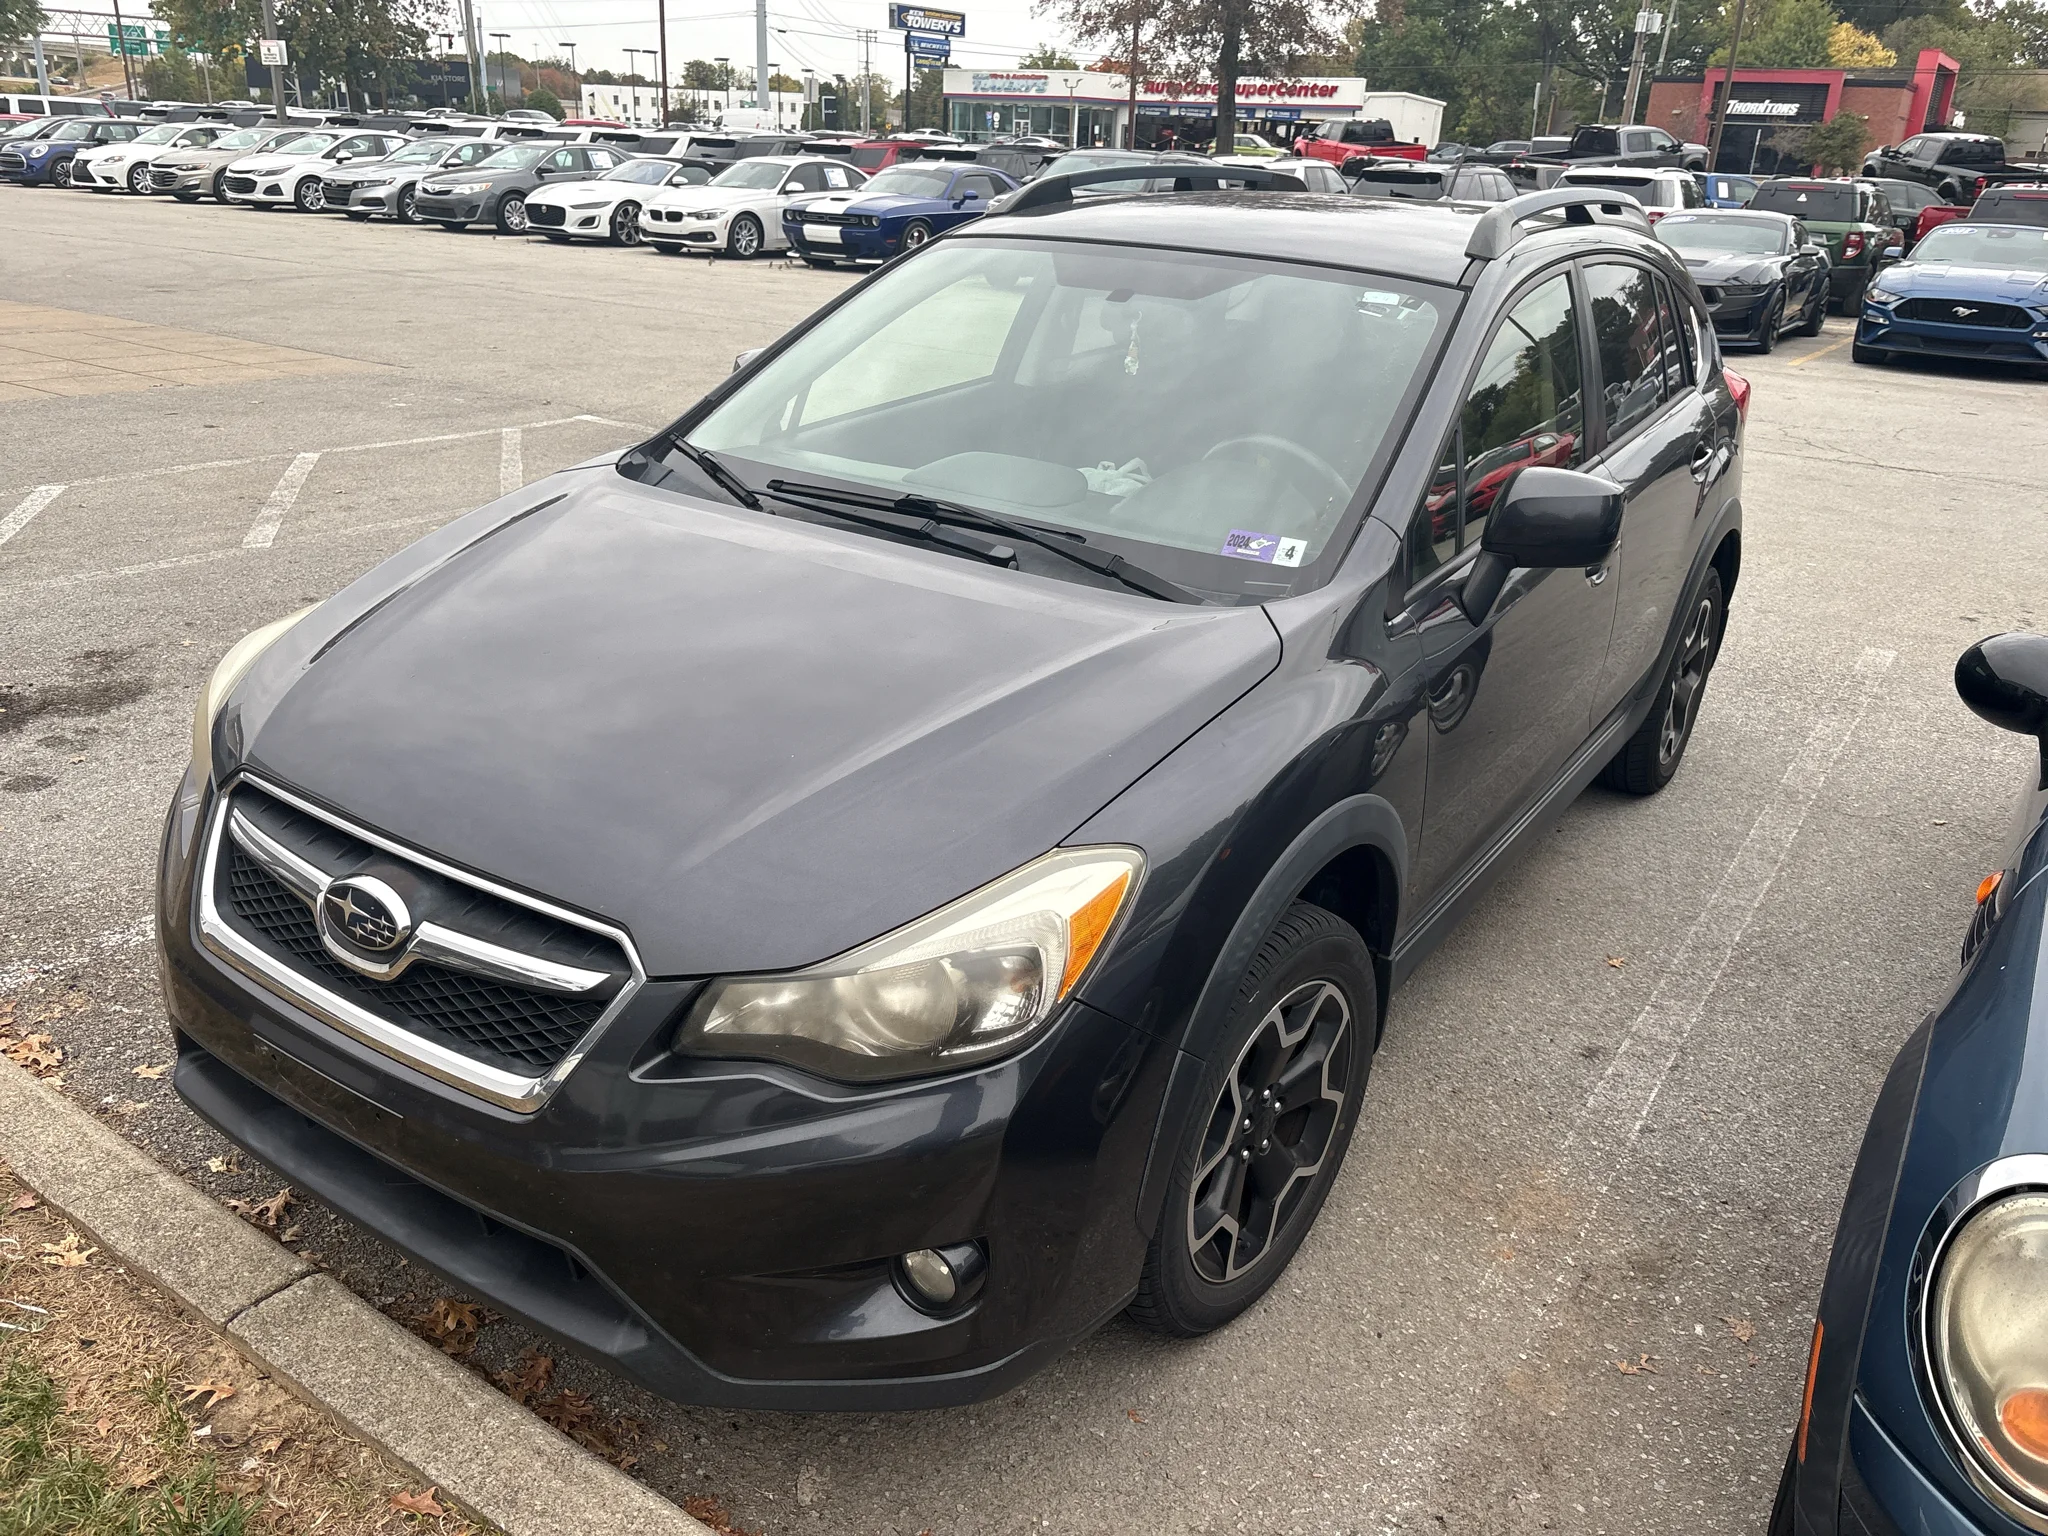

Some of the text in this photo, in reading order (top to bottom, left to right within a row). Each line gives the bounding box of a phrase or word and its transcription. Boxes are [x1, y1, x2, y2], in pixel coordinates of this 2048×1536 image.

[908, 9, 924, 17] KEN
[906, 15, 962, 33] TOWERY'S
[444, 75, 466, 83] STORE
[1143, 80, 1339, 98] AuCare uperCenter
[1226, 533, 1251, 549] 2024
[1285, 545, 1296, 560] 4
